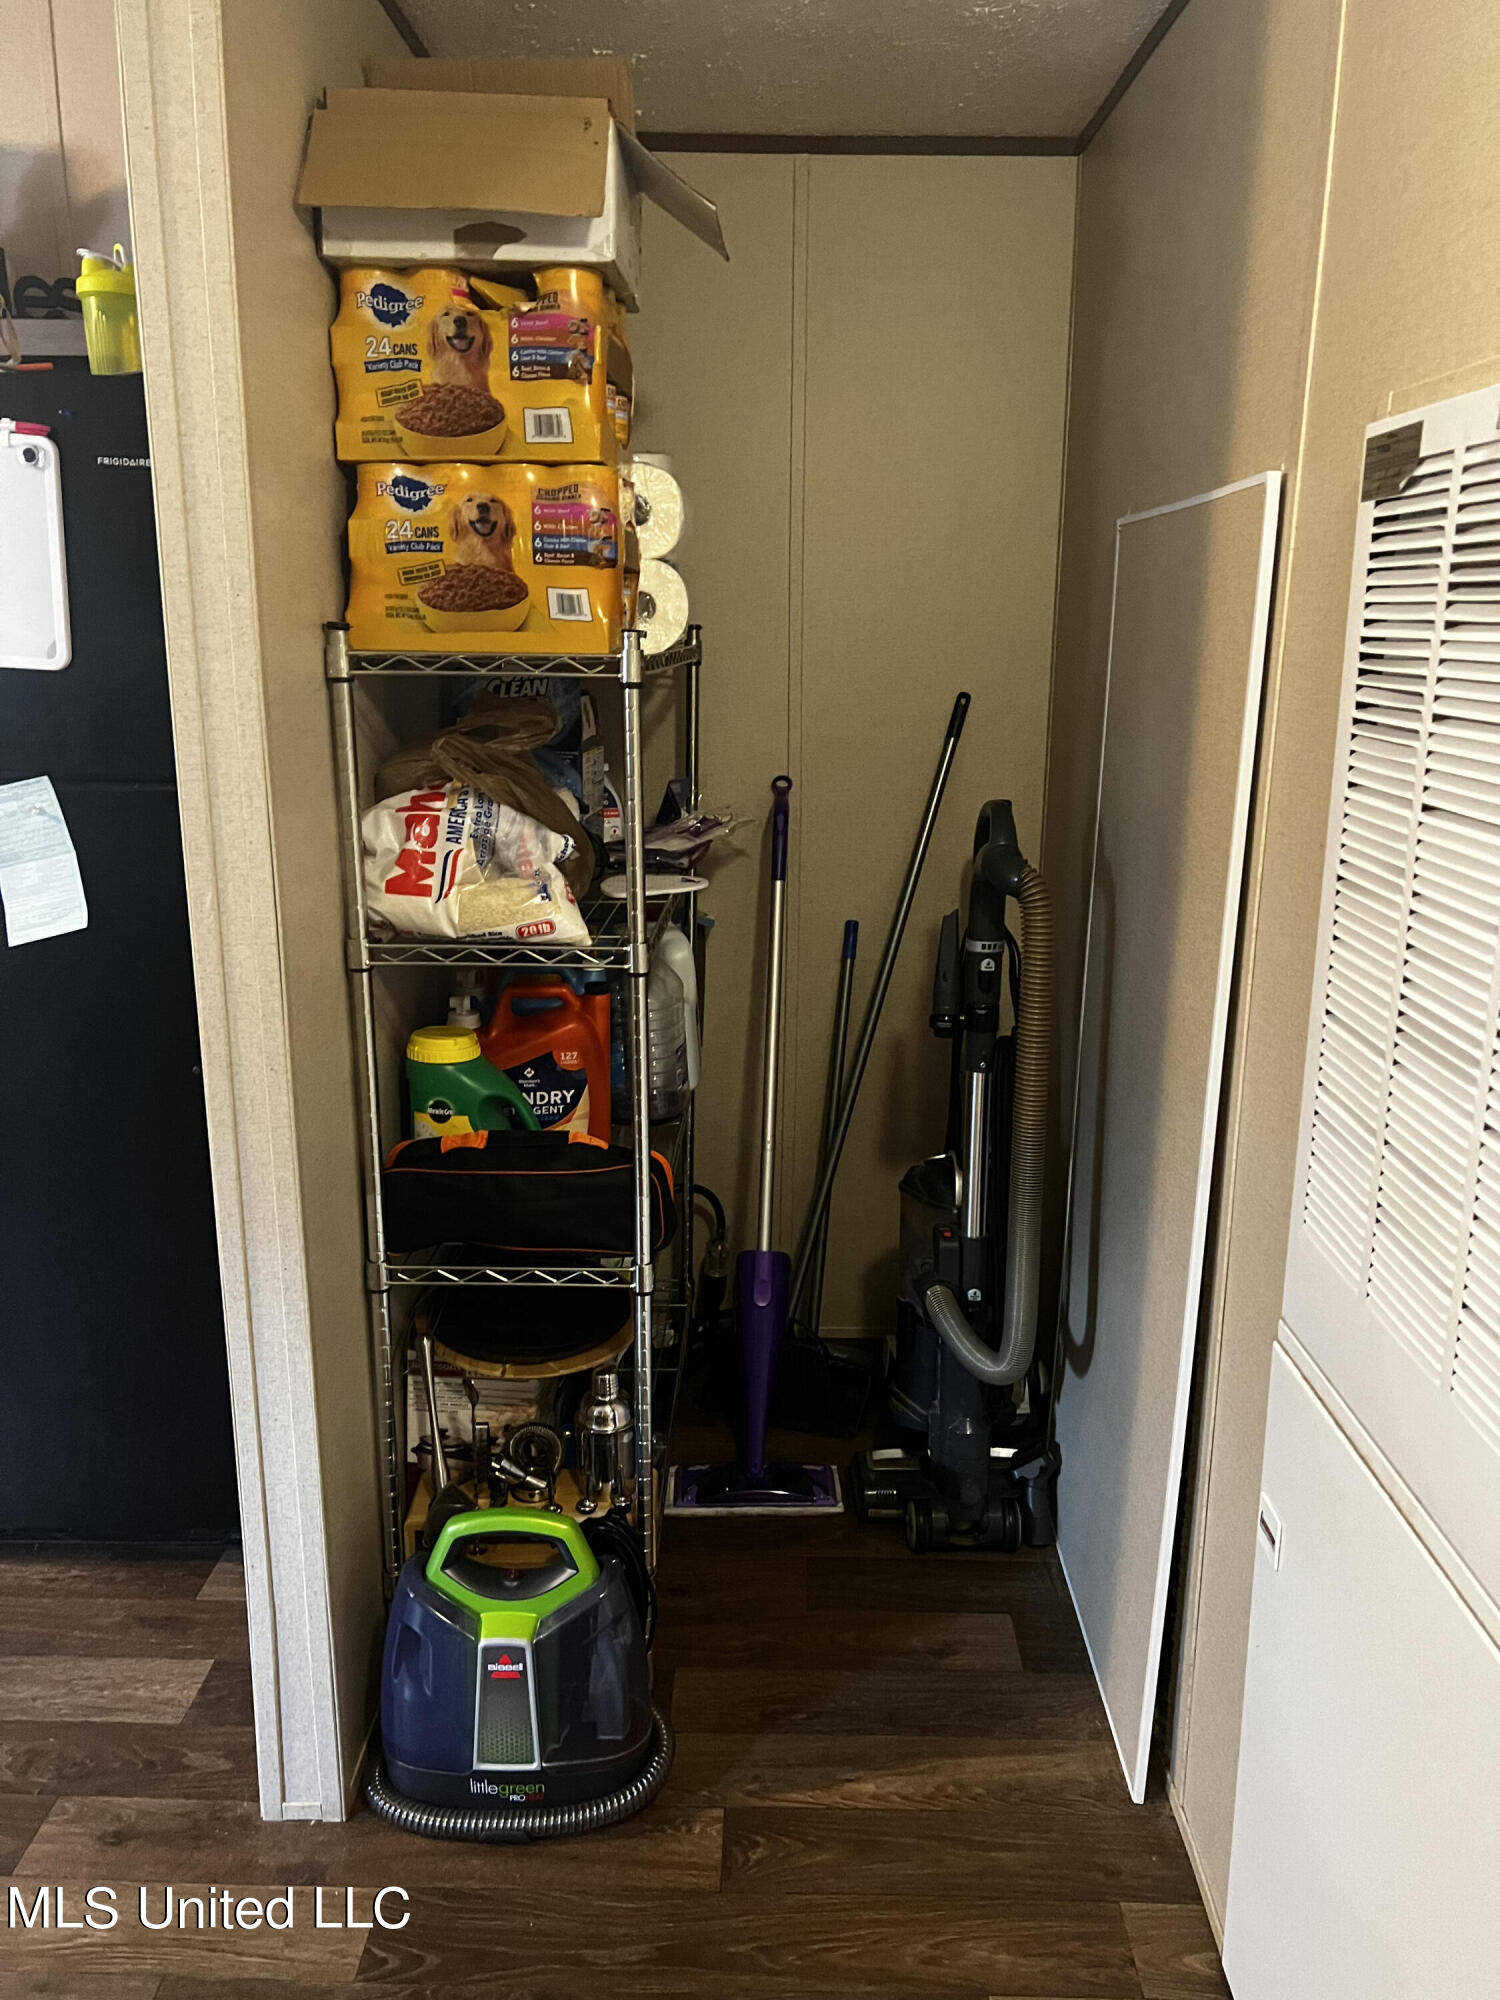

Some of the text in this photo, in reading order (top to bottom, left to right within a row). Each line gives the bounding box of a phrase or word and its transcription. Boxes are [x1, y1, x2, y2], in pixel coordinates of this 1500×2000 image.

[355, 291, 424, 314] Pedigree
[511, 317, 519, 328] 6
[511, 334, 519, 344] 6
[366, 336, 417, 358] 24 CANS
[511, 351, 519, 361] 6
[404, 360, 419, 369] Pack
[512, 366, 520, 377] 6
[376, 481, 445, 501] Pedigree
[534, 505, 542, 515] 6
[385, 519, 439, 540] 24 CANS
[534, 521, 542, 531] 6
[410, 542, 425, 550] Club
[426, 543, 441, 551] Pack
[534, 537, 542, 548] 6
[535, 553, 543, 563] 6
[488, 677, 549, 698] CLEAN
[521, 925, 537, 937] 20
[560, 1051, 578, 1060] 127
[522, 1089, 575, 1105] NDRY
[533, 1104, 565, 1115] GENT
